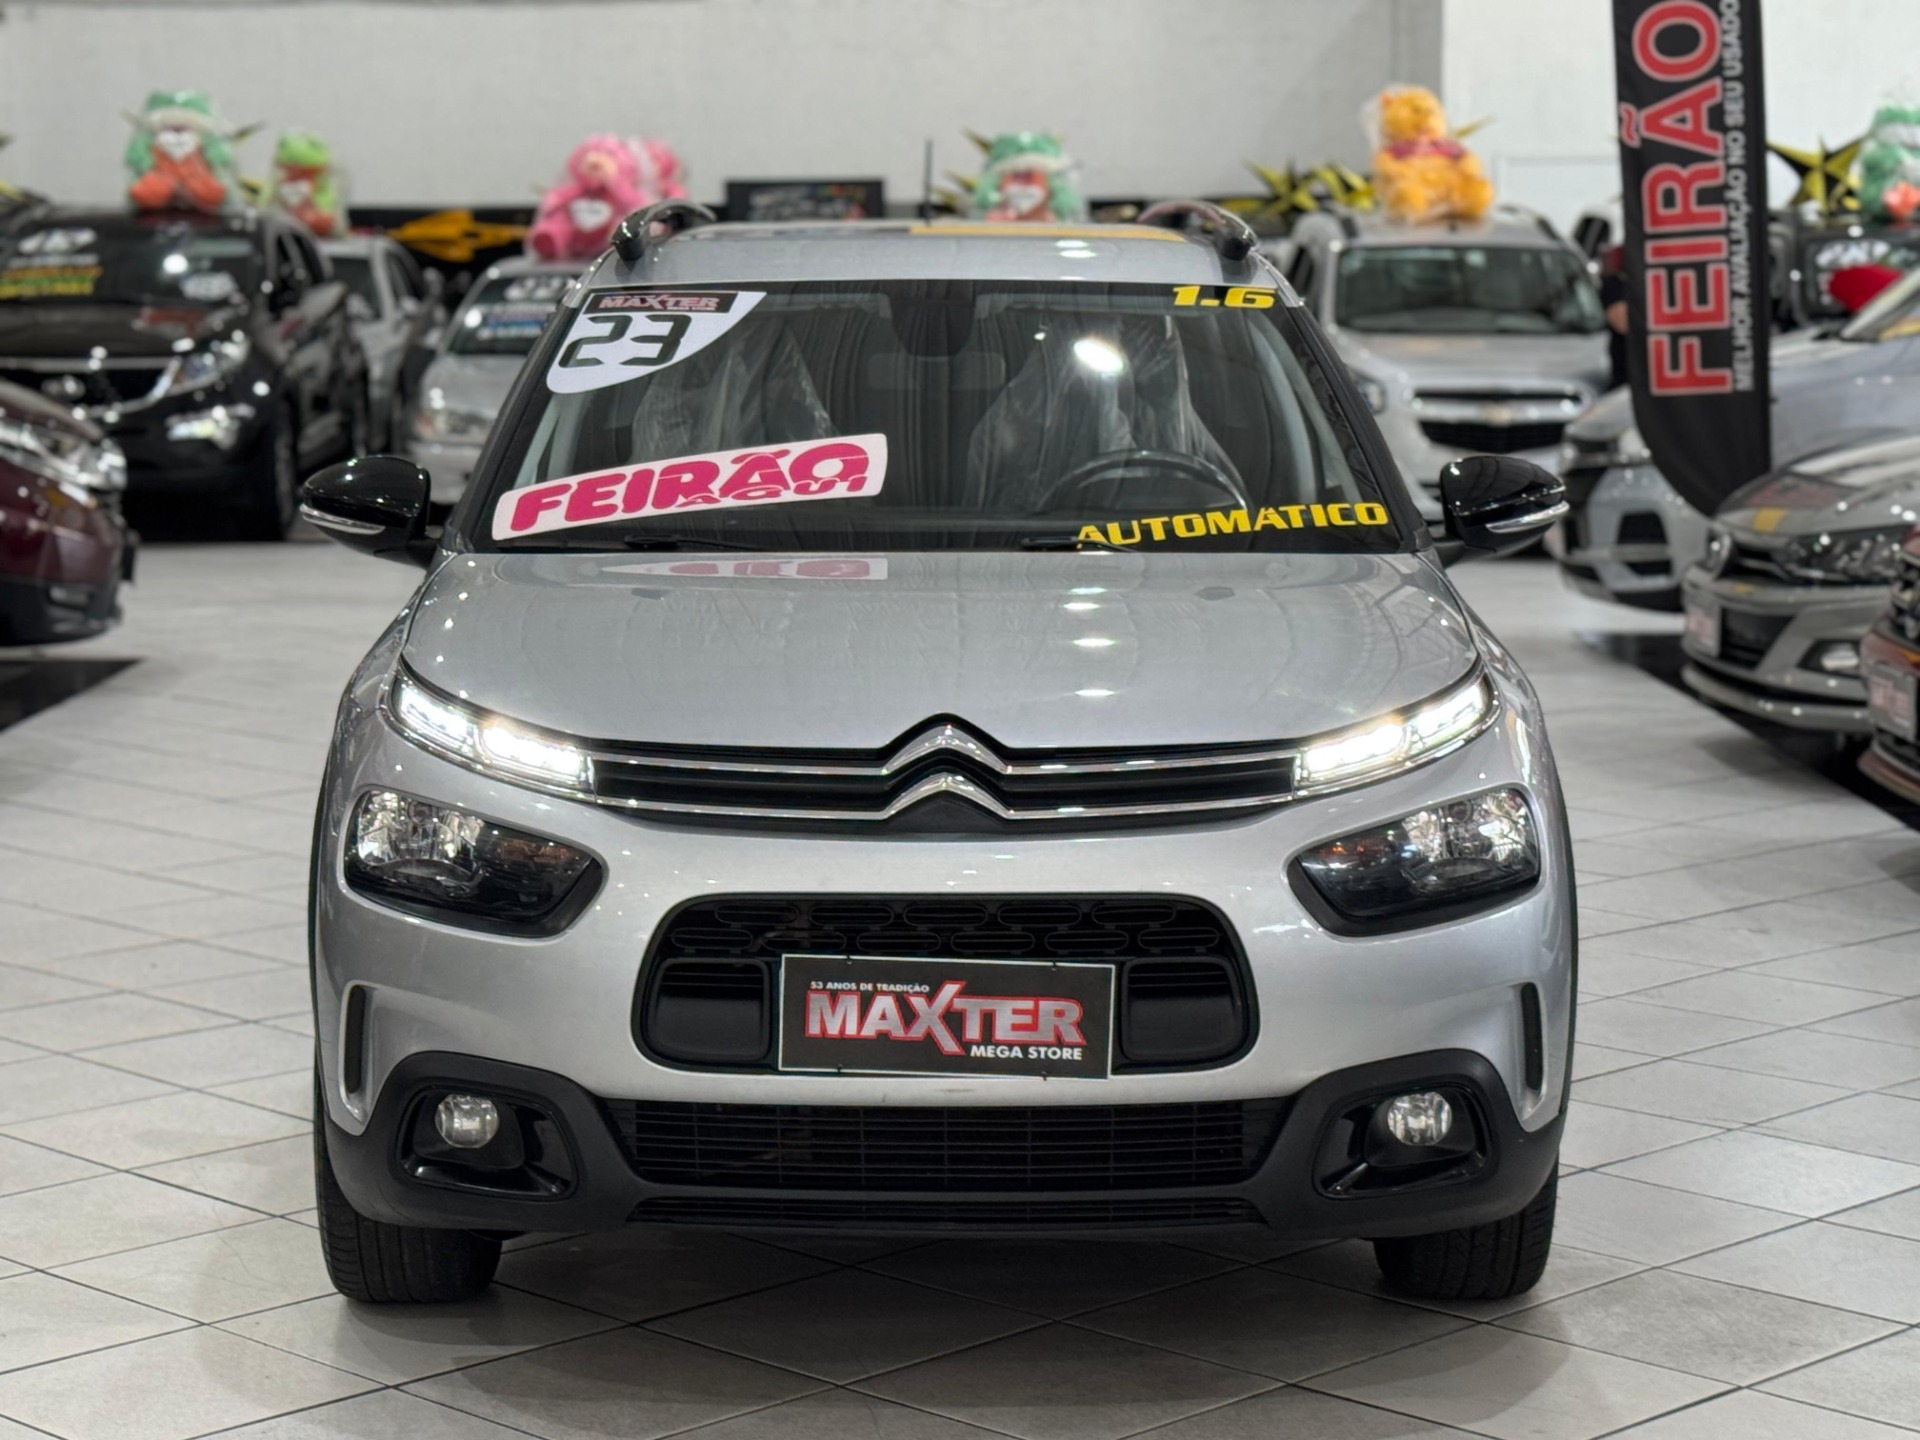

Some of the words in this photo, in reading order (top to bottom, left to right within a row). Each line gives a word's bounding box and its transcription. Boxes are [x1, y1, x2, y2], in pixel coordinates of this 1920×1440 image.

[1719, 0, 1743, 77] USADO
[1722, 80, 1745, 128] SEU
[1725, 130, 1746, 166] NO
[1620, 0, 1733, 396] FEIRÃO
[1722, 168, 1751, 295] AVALIAÇÃO
[599, 293, 720, 310] MAXTER
[1173, 285, 1276, 309] 1.6
[559, 314, 692, 368] 23
[1731, 297, 1754, 391] MELHOR
[510, 442, 870, 532] FEIRÃO
[1076, 502, 1389, 549] AUTOMÁTICO
[810, 981, 823, 989] 53
[825, 982, 857, 991] ANOS
[859, 983, 874, 991] DE
[876, 983, 930, 993] TRADIÇÃO
[805, 980, 1087, 1055] MAXTER
[970, 1045, 1023, 1059] MEGA
[1028, 1046, 1083, 1060] STORE
